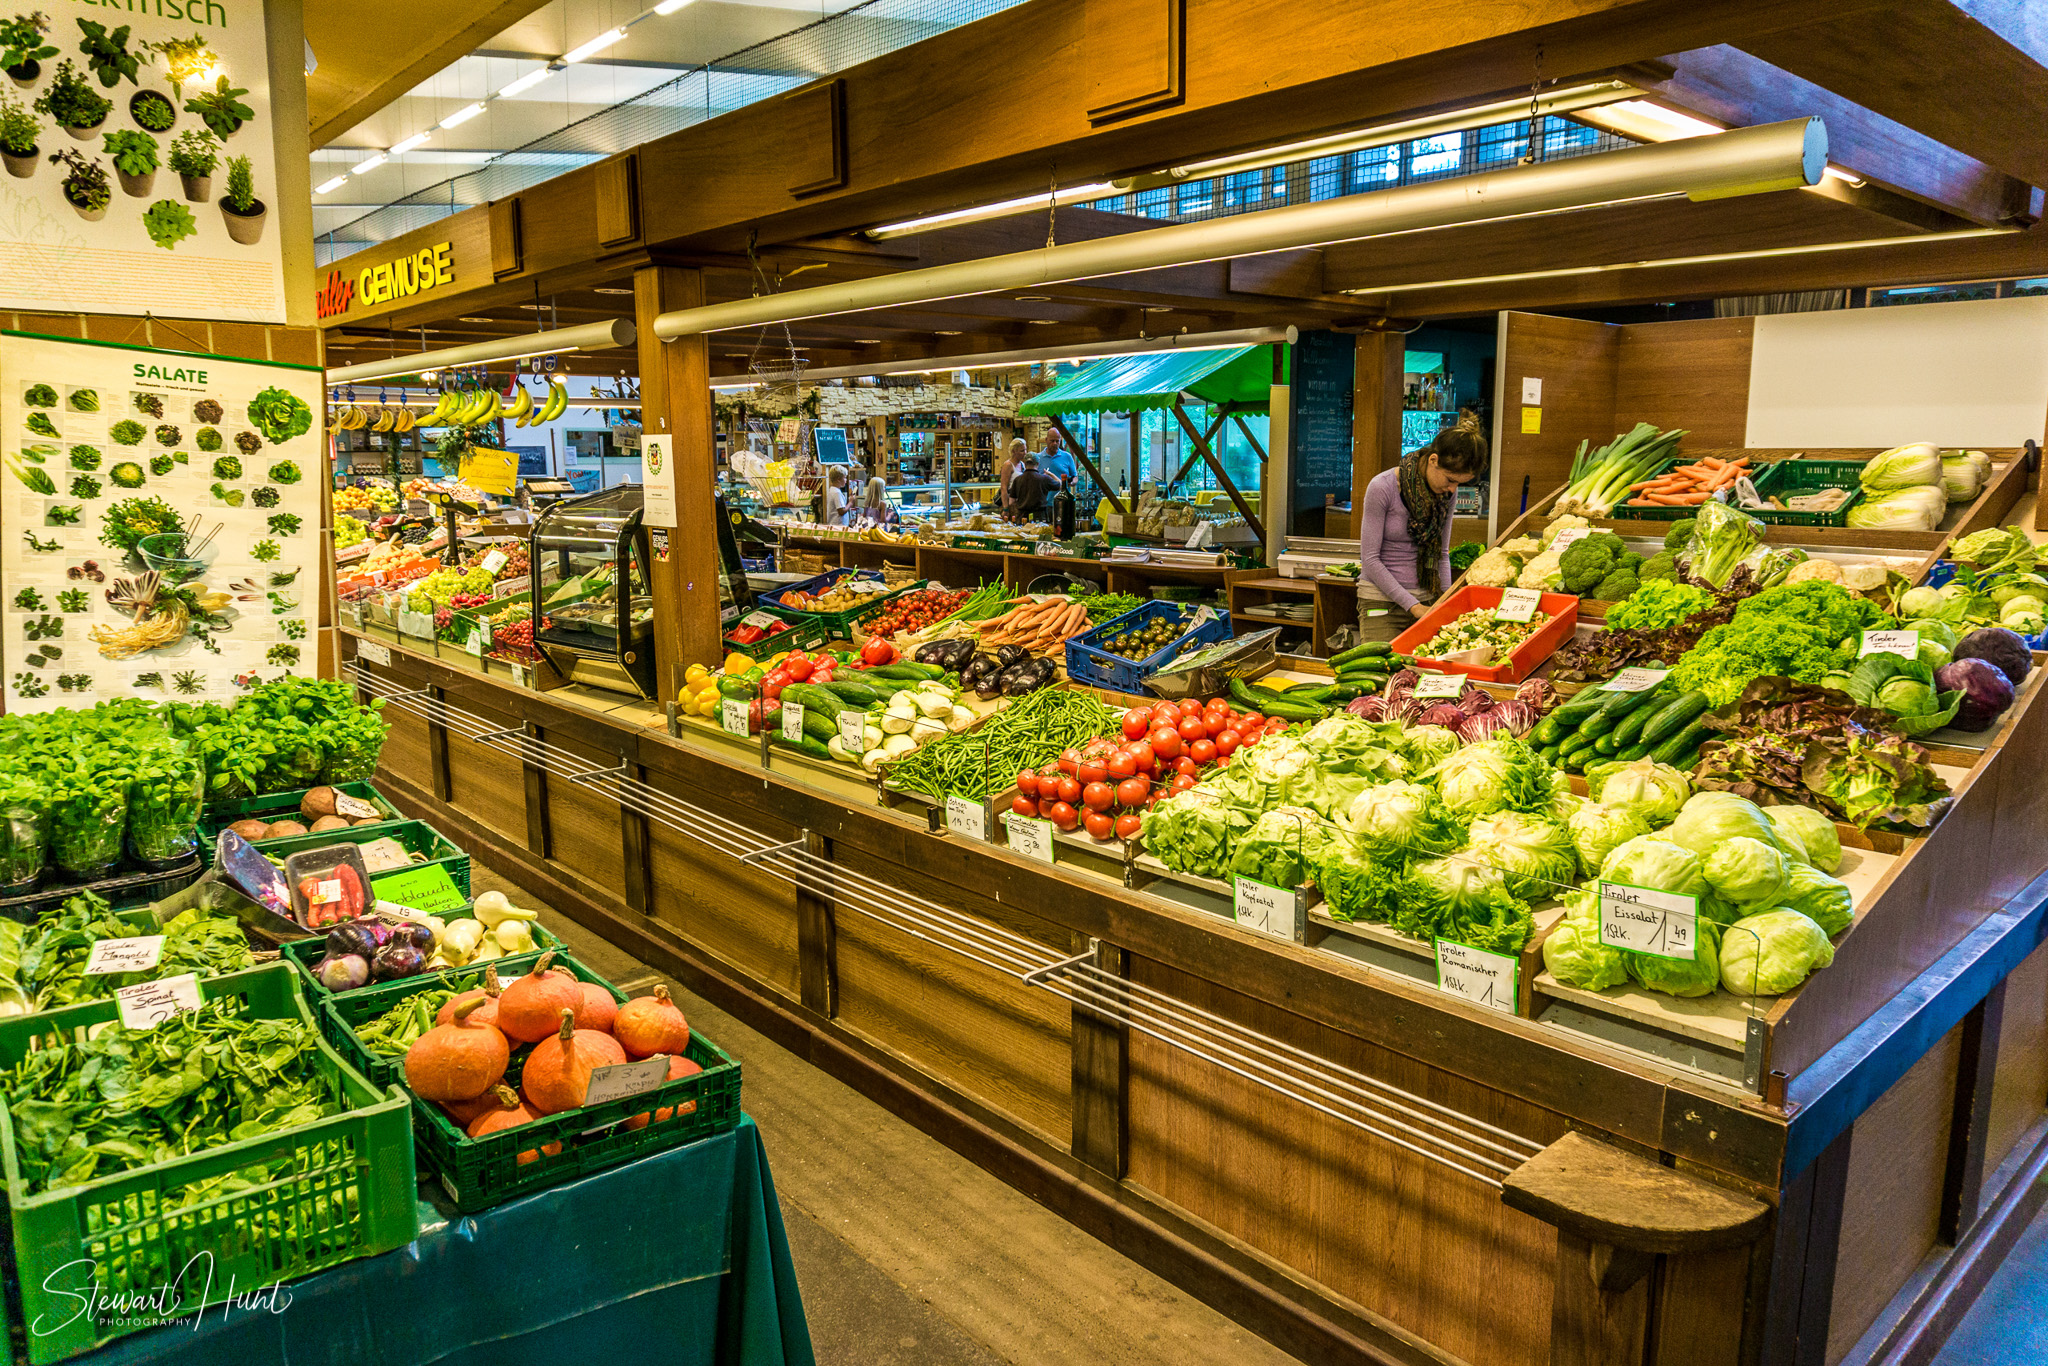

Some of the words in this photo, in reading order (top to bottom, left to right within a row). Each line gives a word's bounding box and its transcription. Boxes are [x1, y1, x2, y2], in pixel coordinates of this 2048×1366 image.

[359, 241, 453, 306] GEMÜSE
[133, 363, 208, 385] SALATE
[1236, 877, 1260, 893] Tiroler
[1600, 882, 1640, 904] Tiroler
[1614, 905, 1660, 925] Eissalat
[1436, 940, 1467, 958] Tiroler
[1441, 953, 1499, 978] Romanischer
[117, 983, 158, 997] Tiroler
[131, 989, 174, 1007] Spinat
